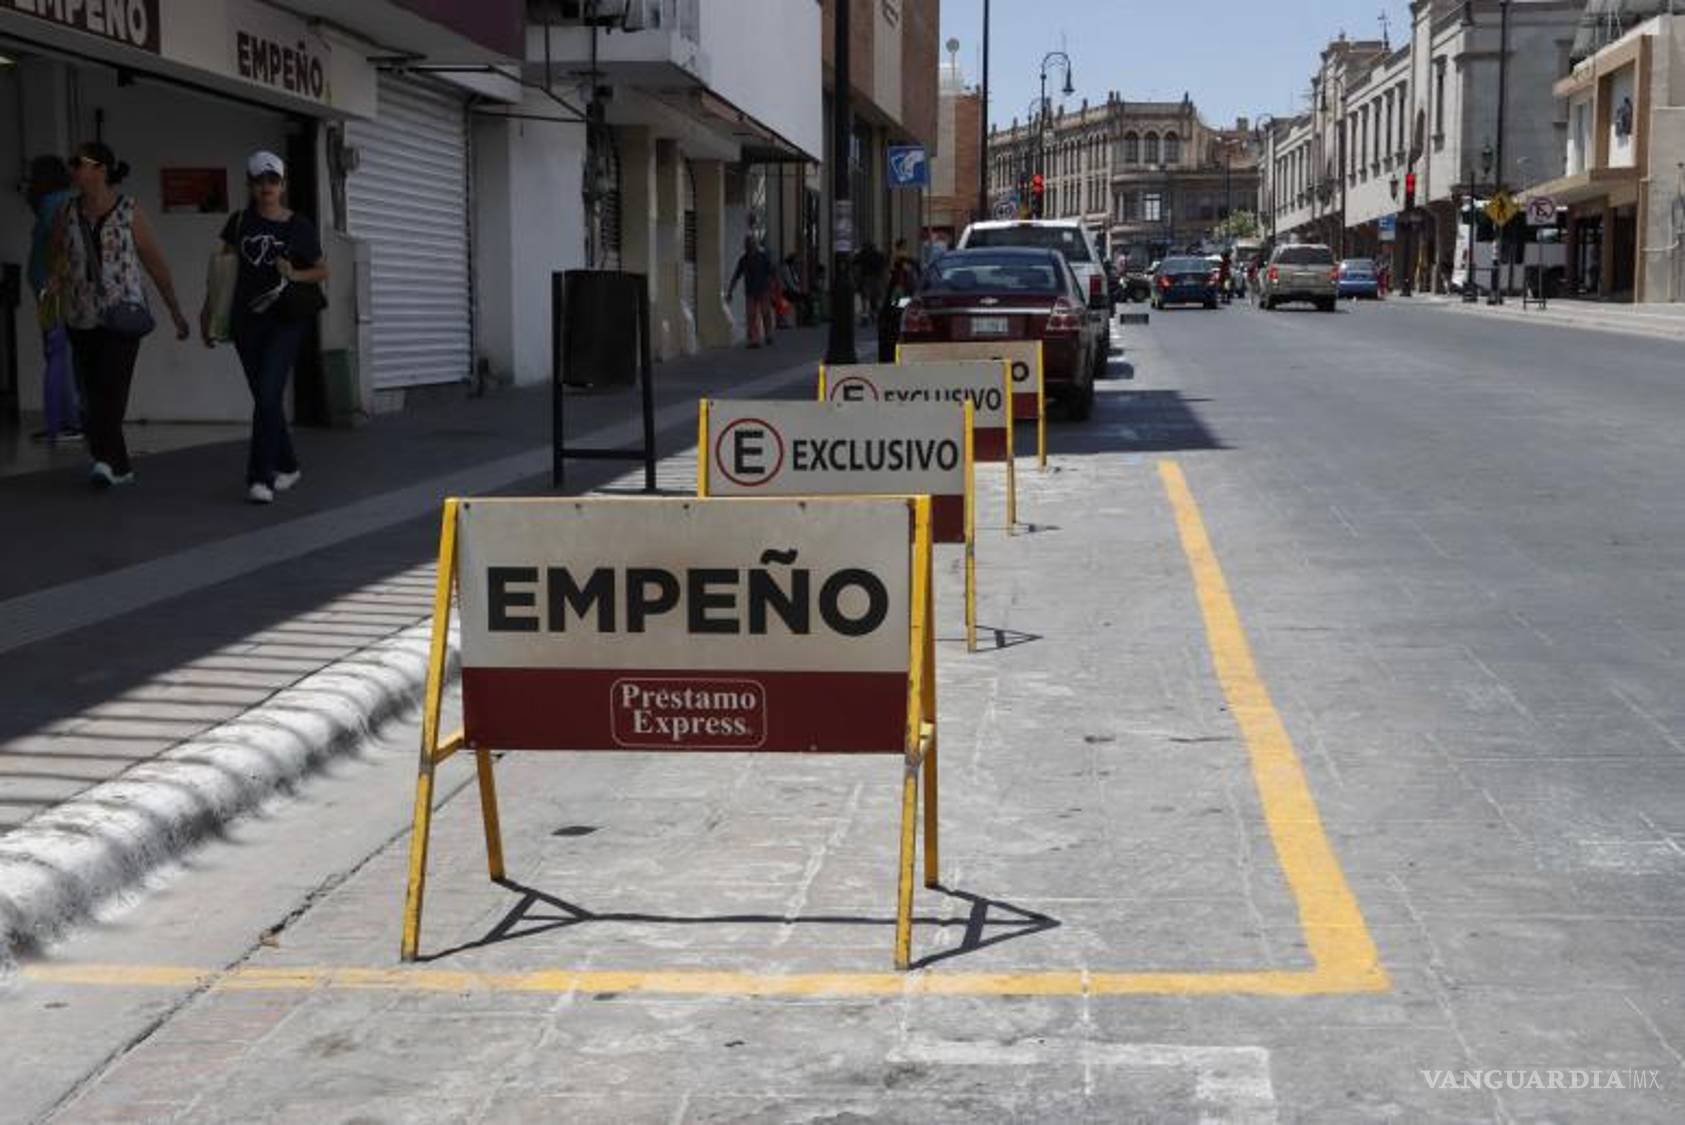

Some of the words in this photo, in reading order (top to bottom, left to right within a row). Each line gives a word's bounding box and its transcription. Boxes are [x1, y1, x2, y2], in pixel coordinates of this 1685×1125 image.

[237, 30, 324, 98] EMPEÑO
[733, 430, 766, 474] E
[792, 439, 959, 472] EXCLUSIVO
[487, 548, 890, 637] EMPEÑO
